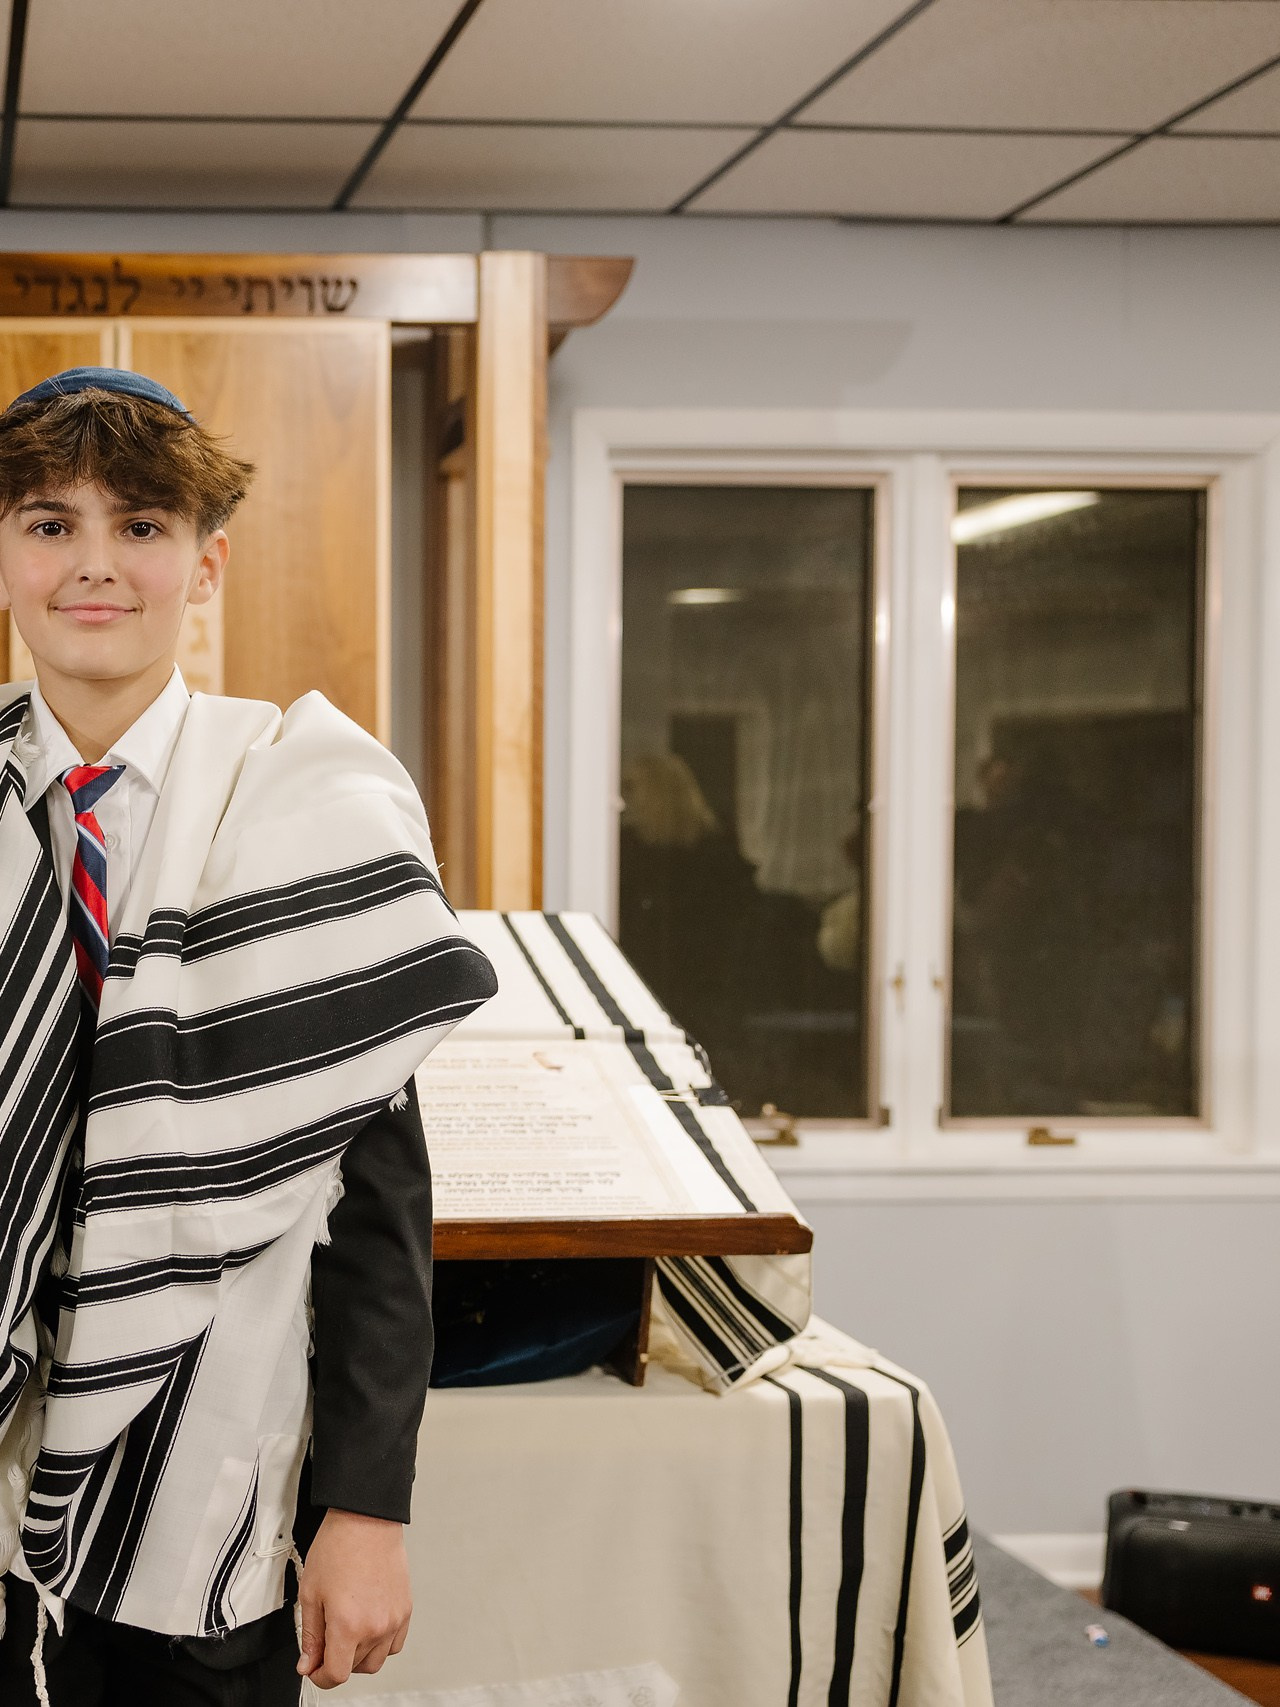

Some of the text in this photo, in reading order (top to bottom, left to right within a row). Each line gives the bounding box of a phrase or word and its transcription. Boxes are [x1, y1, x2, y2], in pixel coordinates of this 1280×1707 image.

[14, 257, 142, 313] לנגדי
[168, 274, 206, 298] יי
[223, 274, 359, 313] שויתי
